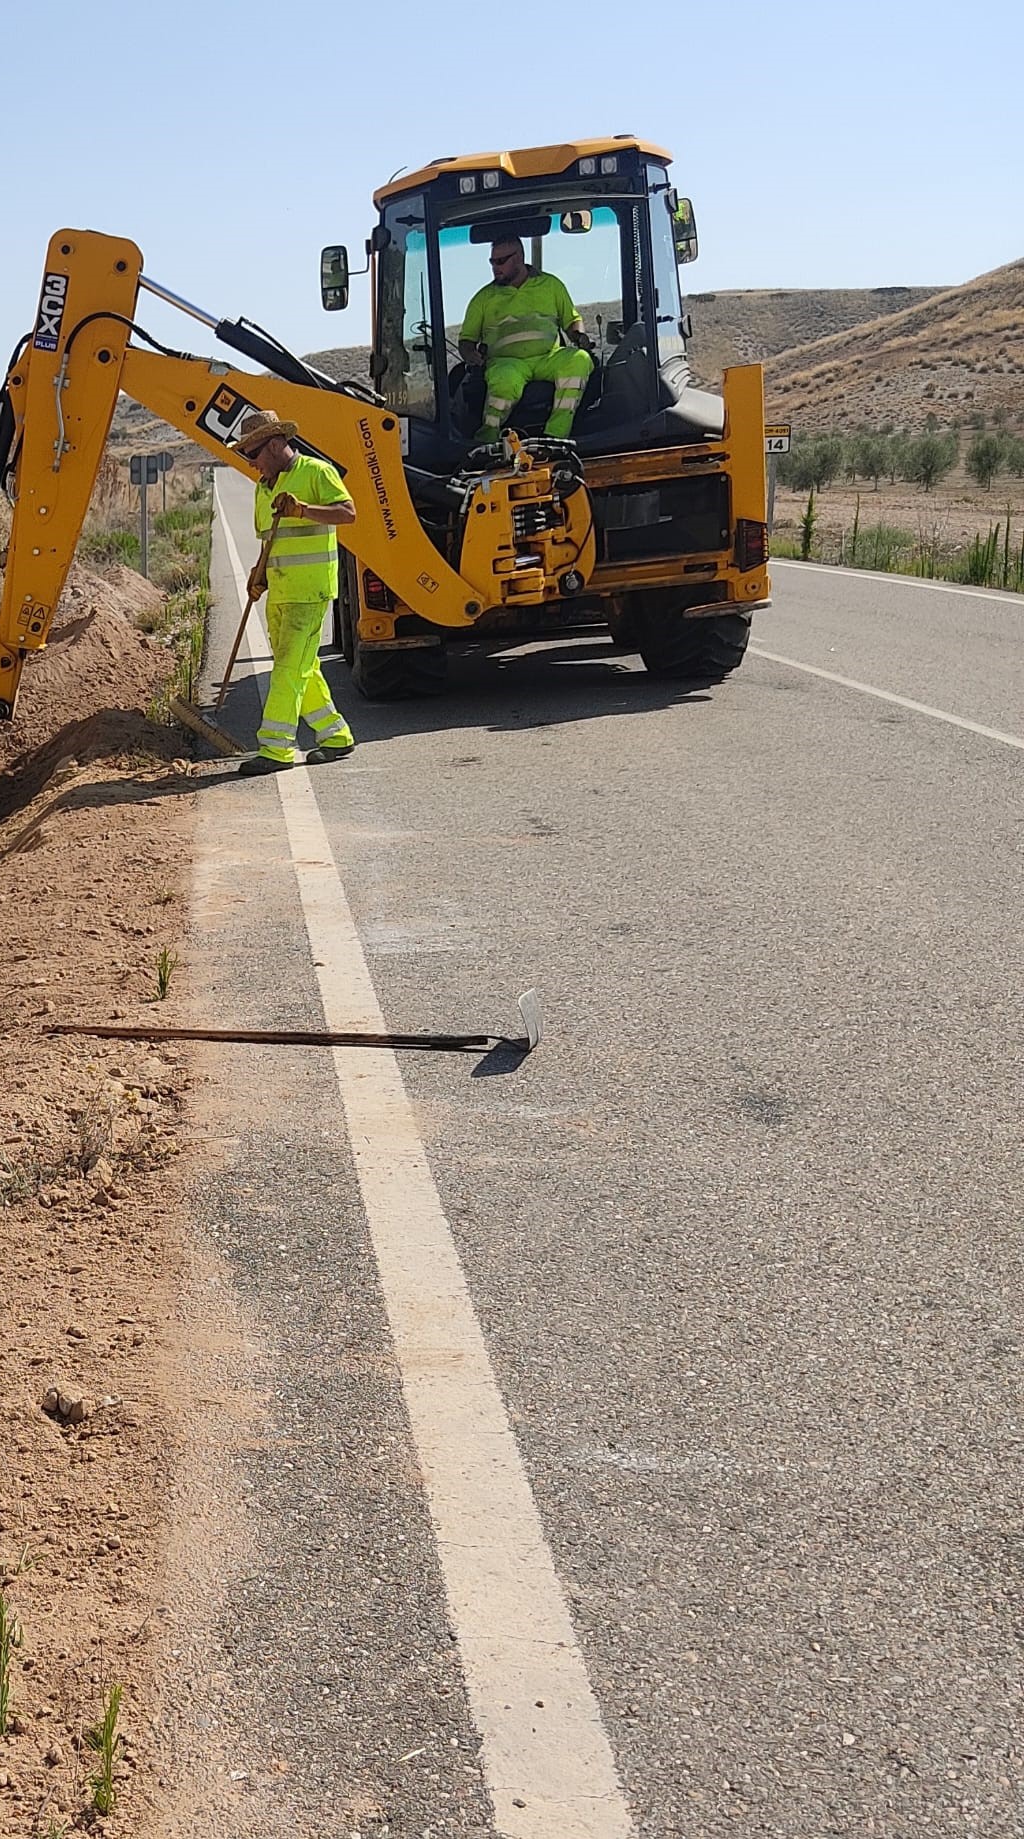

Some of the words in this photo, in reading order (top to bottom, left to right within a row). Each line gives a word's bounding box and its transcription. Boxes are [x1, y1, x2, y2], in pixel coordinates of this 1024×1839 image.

[37, 275, 67, 336] 3CX
[767, 439, 784, 451] 14
[359, 418, 397, 540] www.sumialki.com
